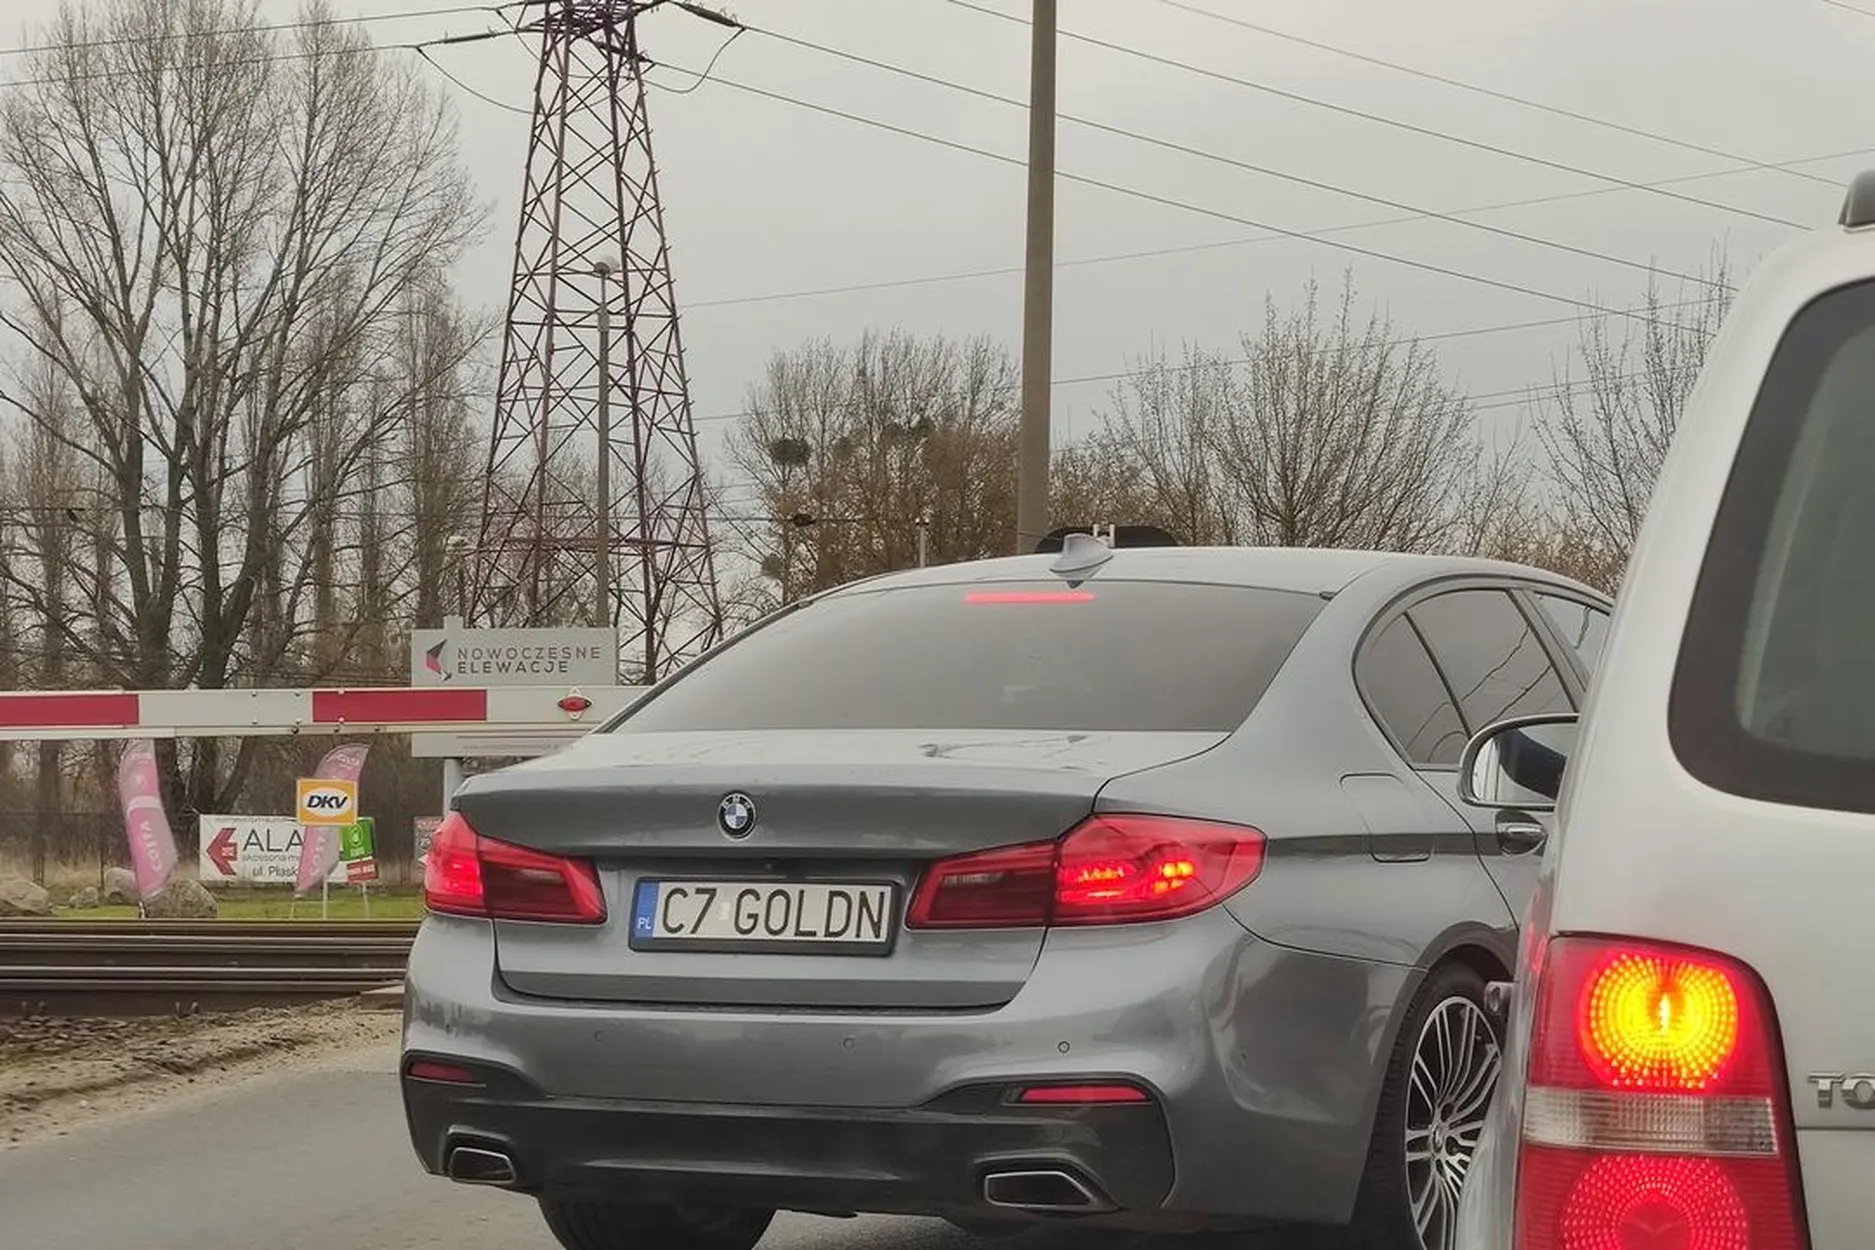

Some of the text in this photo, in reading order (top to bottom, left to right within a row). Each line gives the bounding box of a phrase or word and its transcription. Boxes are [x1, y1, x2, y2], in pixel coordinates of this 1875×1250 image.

[457, 647, 601, 661] NOWOCZESNE
[457, 661, 569, 674] ELEWACJE
[306, 795, 348, 809] DKV
[661, 888, 885, 939] C7 GOLDN
[636, 916, 652, 930] PL
